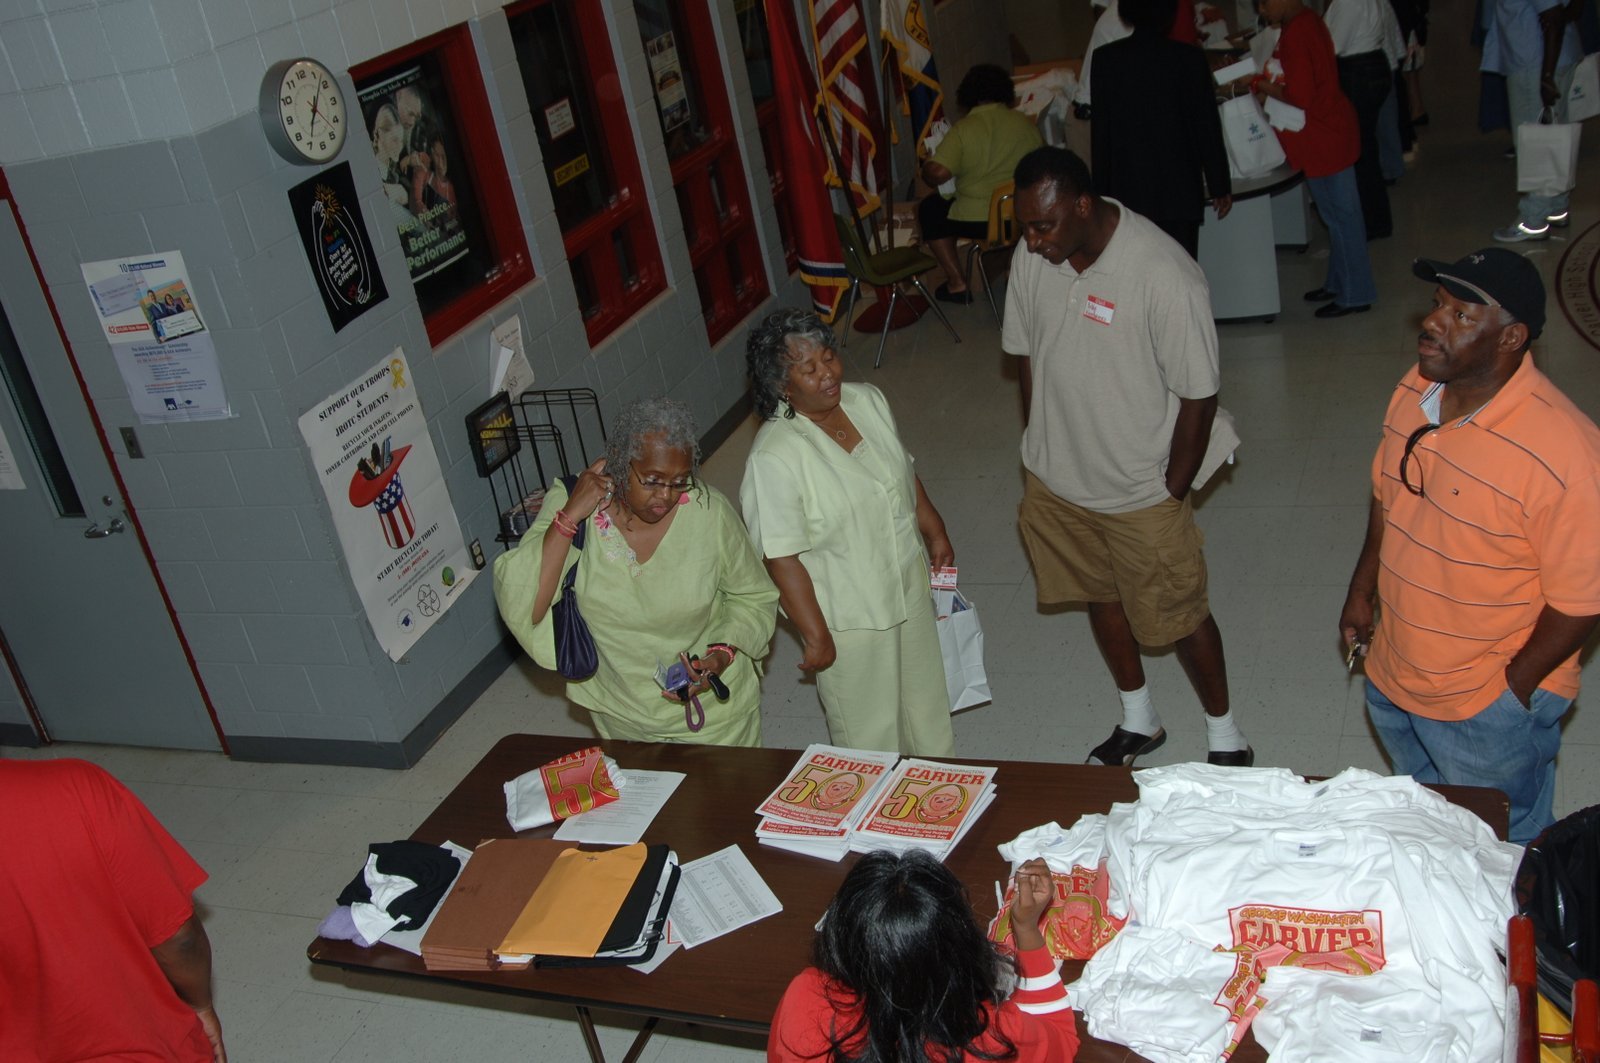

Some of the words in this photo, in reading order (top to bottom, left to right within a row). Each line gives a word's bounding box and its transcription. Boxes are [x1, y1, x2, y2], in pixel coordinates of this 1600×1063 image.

[295, 70, 306, 80] 12
[311, 71, 317, 79] 1
[286, 79, 296, 90] 11
[321, 80, 329, 89] 2
[281, 96, 293, 107] 10
[330, 96, 337, 106] 3
[286, 115, 294, 125] 9
[332, 115, 339, 124] 4
[295, 132, 303, 142] 8
[328, 131, 336, 141] 5
[307, 141, 313, 150] 7
[319, 141, 327, 151] 6
[398, 216, 418, 235] Best
[408, 227, 440, 253] Better
[119, 263, 128, 274] 10
[1566, 275, 1587, 299] High
[318, 395, 350, 421] SUPPORT
[350, 384, 365, 400] OUR
[365, 365, 391, 388] TROOPS
[356, 399, 363, 408] &
[335, 416, 356, 437] JROTC
[356, 392, 389, 421] STUDENTS
[342, 433, 361, 451] RECYCLE
[360, 424, 373, 437] YOUR
[367, 432, 377, 443] AND
[377, 562, 395, 581] START
[394, 540, 422, 566] RECYCLING
[810, 754, 885, 776] CARVER
[905, 767, 987, 785] CARVER
[778, 763, 865, 811] 50
[880, 777, 969, 824] 50
[1239, 907, 1287, 922] GEORGE
[1288, 910, 1364, 927] WASHINGTON
[1238, 920, 1376, 953] CARVER
